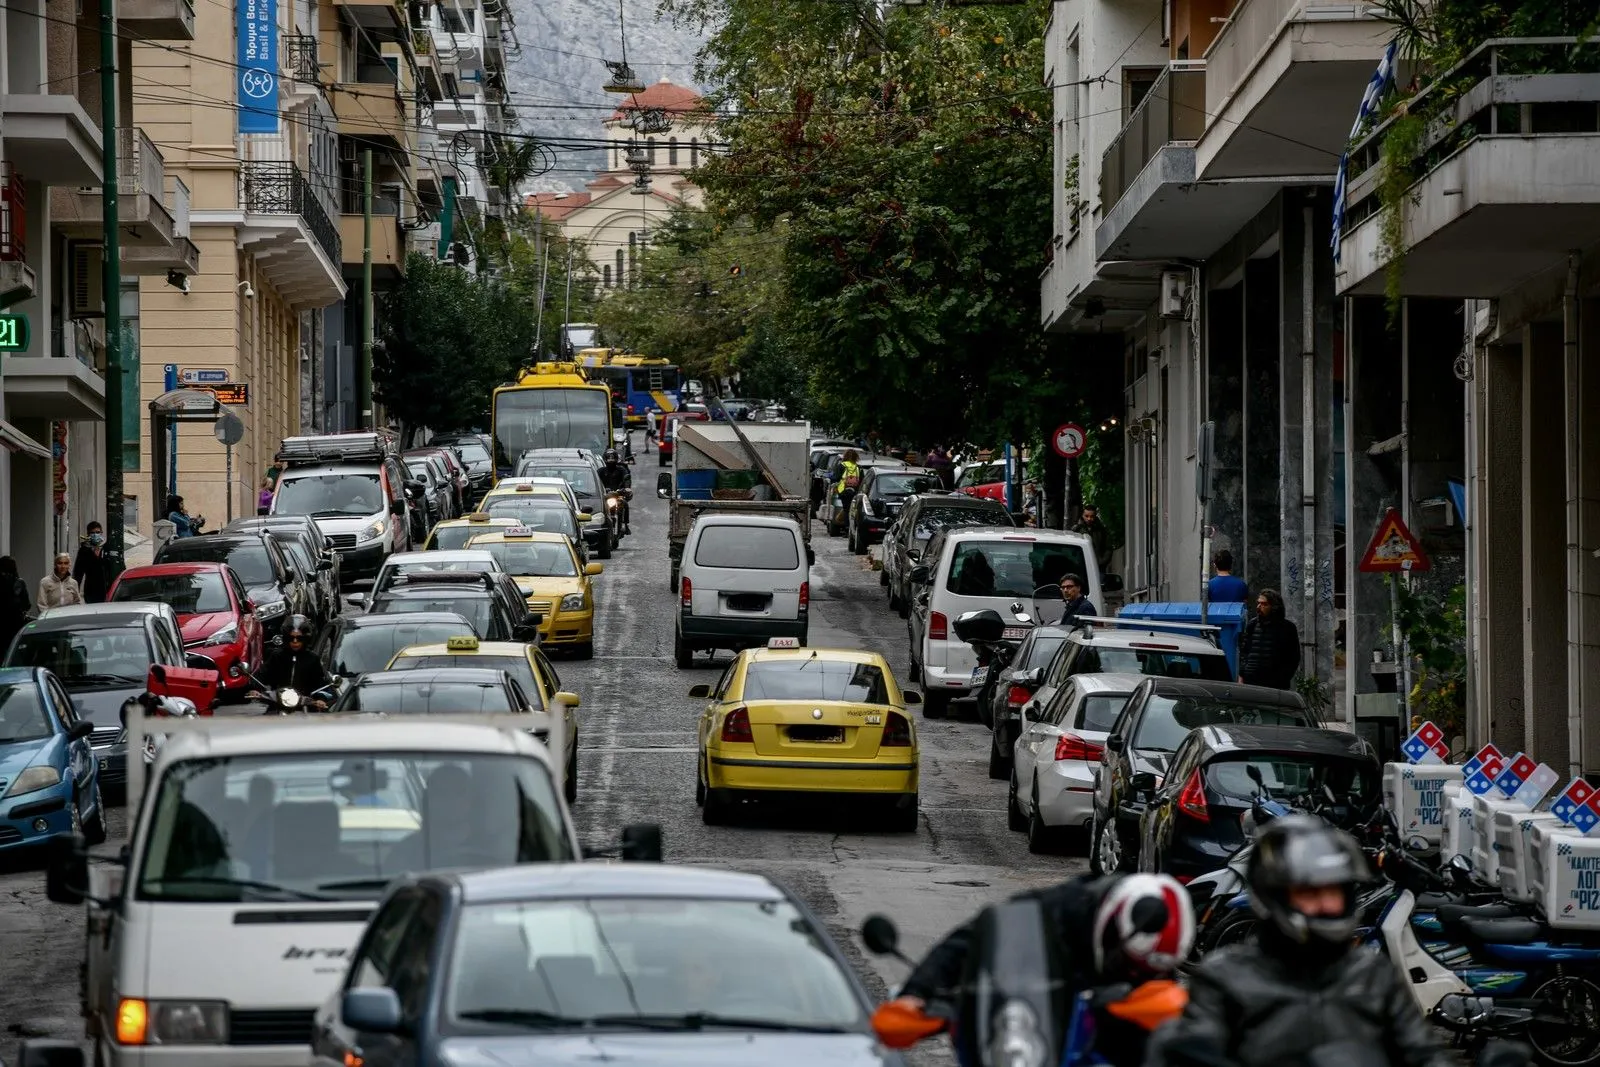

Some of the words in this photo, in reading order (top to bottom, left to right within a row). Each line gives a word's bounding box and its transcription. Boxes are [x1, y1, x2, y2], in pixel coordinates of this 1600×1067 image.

[260, 35, 269, 60] Basil
[774, 639, 794, 647] TAXI
[281, 945, 353, 960] bra
